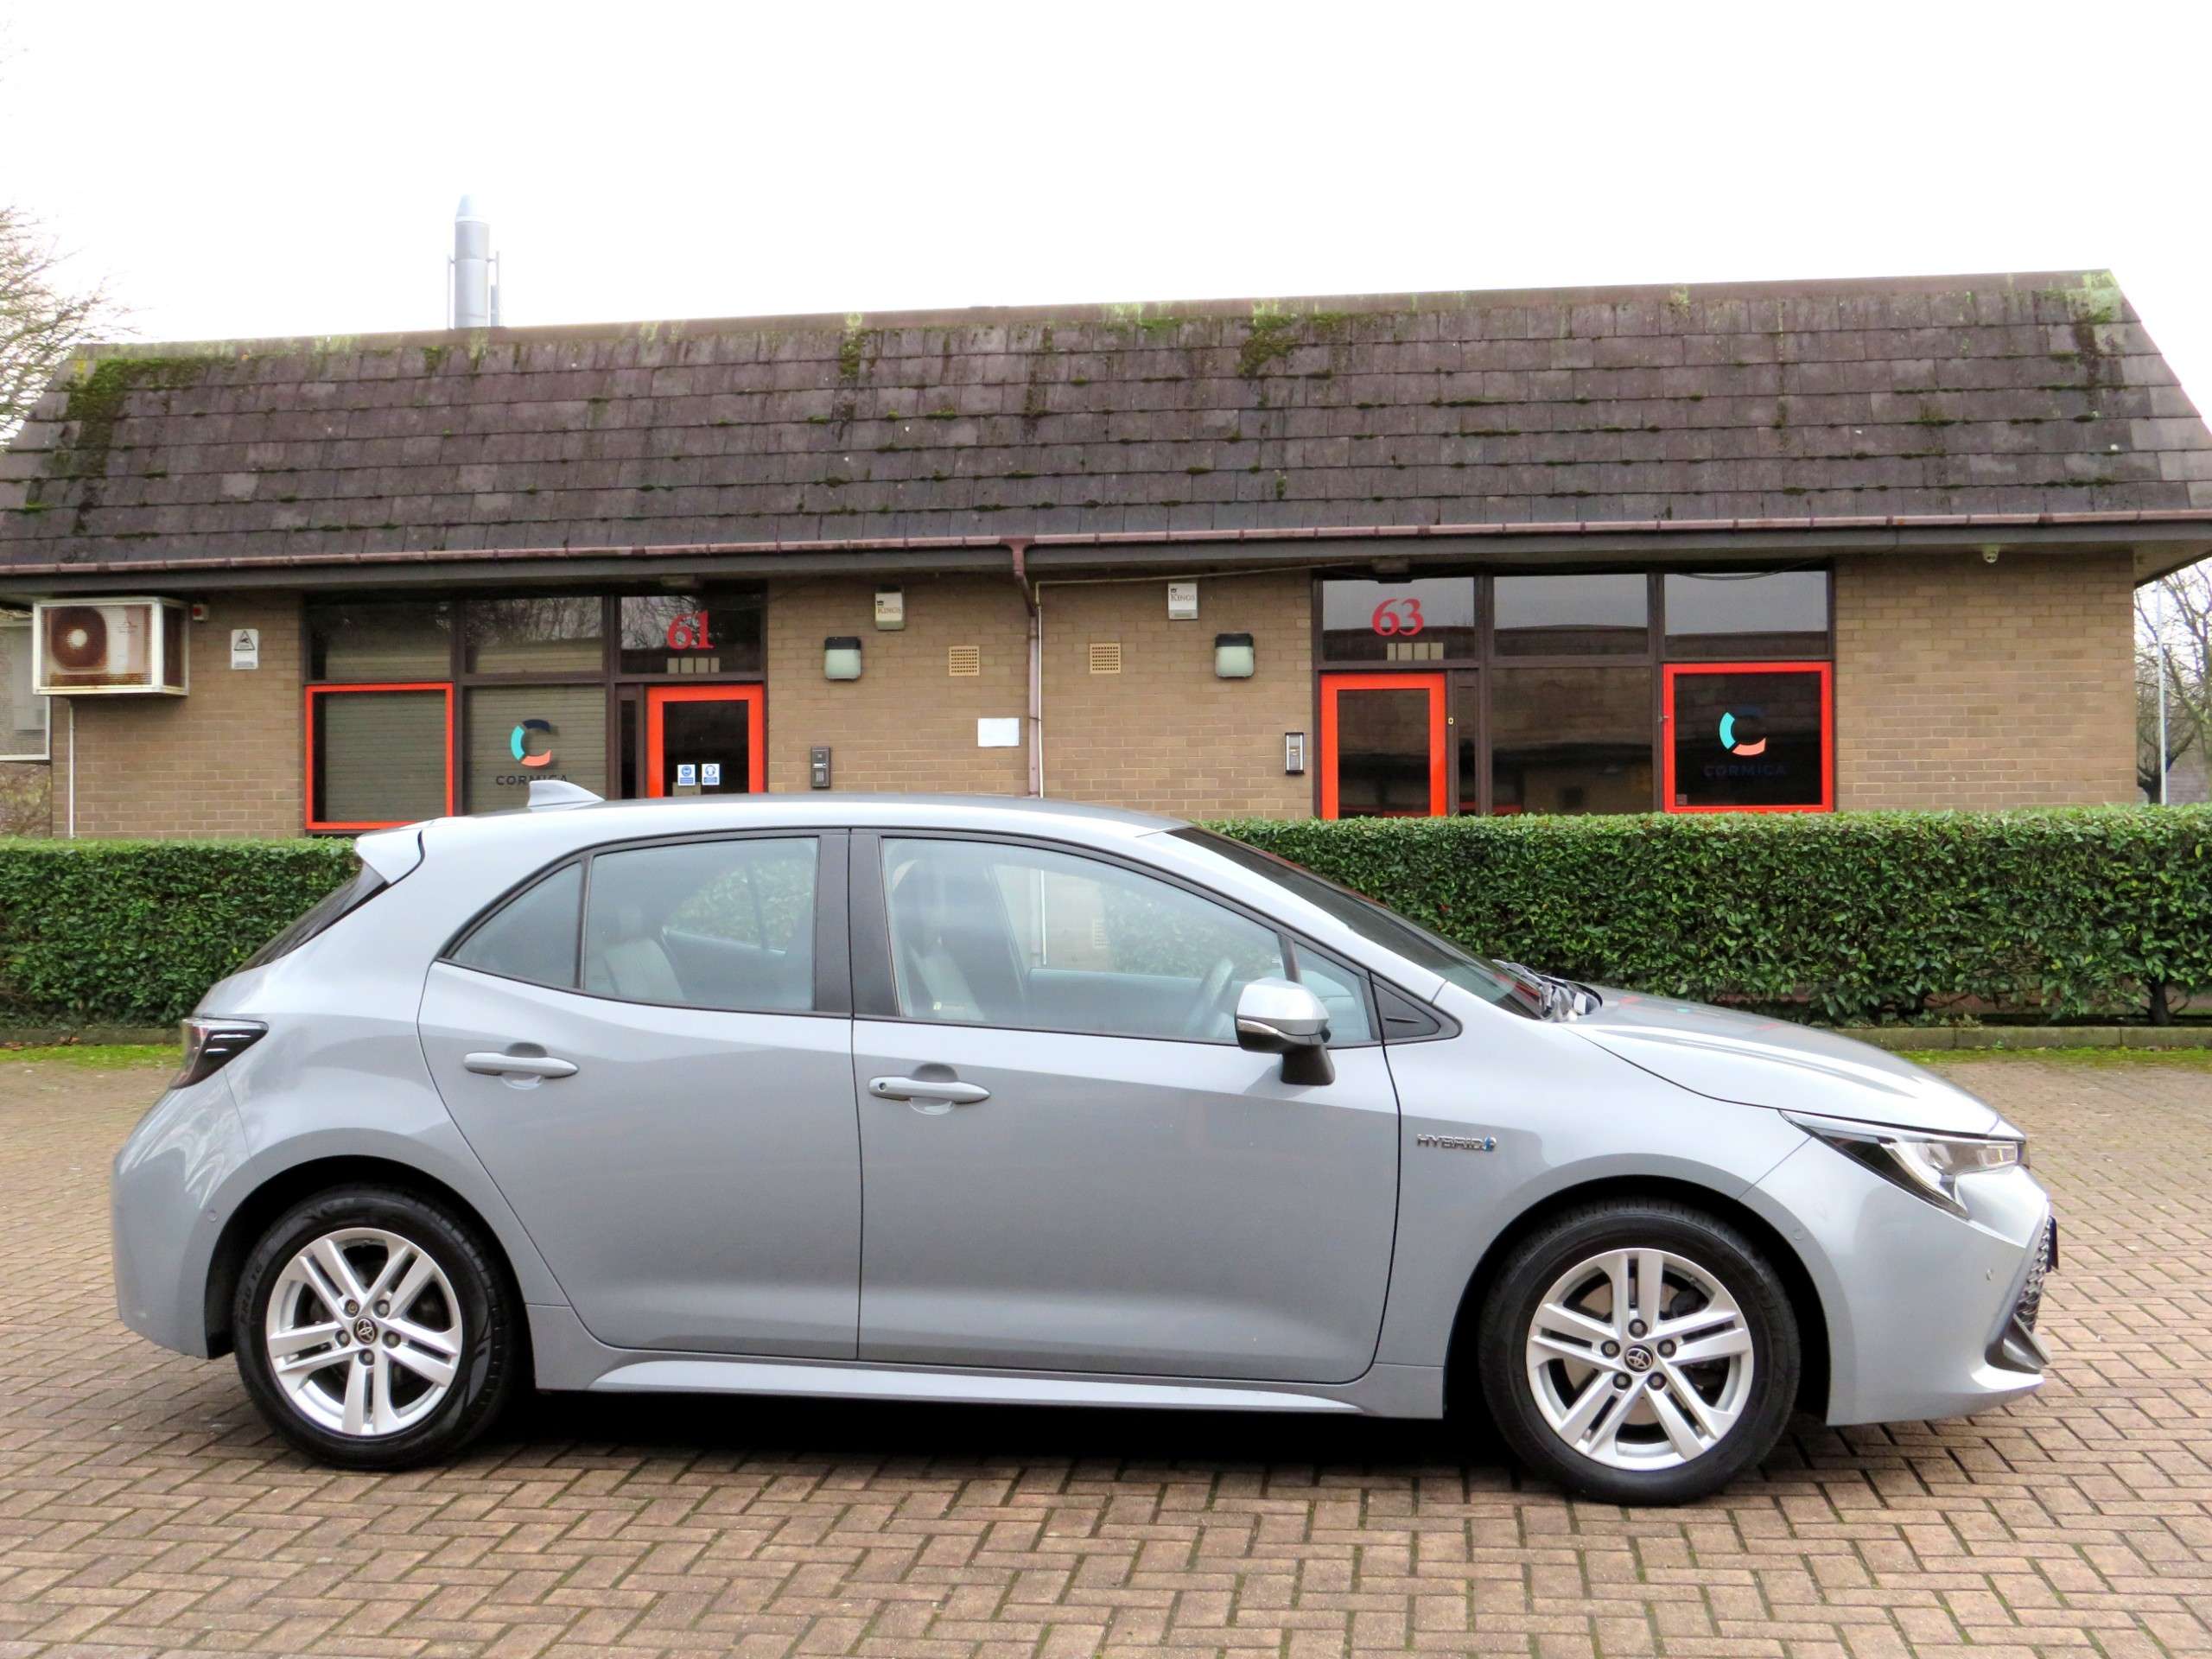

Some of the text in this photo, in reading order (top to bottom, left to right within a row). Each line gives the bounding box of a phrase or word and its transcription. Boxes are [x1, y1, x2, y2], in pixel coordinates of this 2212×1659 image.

[668, 609, 716, 650] 61
[1372, 597, 1424, 636] 63
[1702, 765, 1786, 777] CORMICA
[1416, 1134, 1484, 1150] HYBRID
